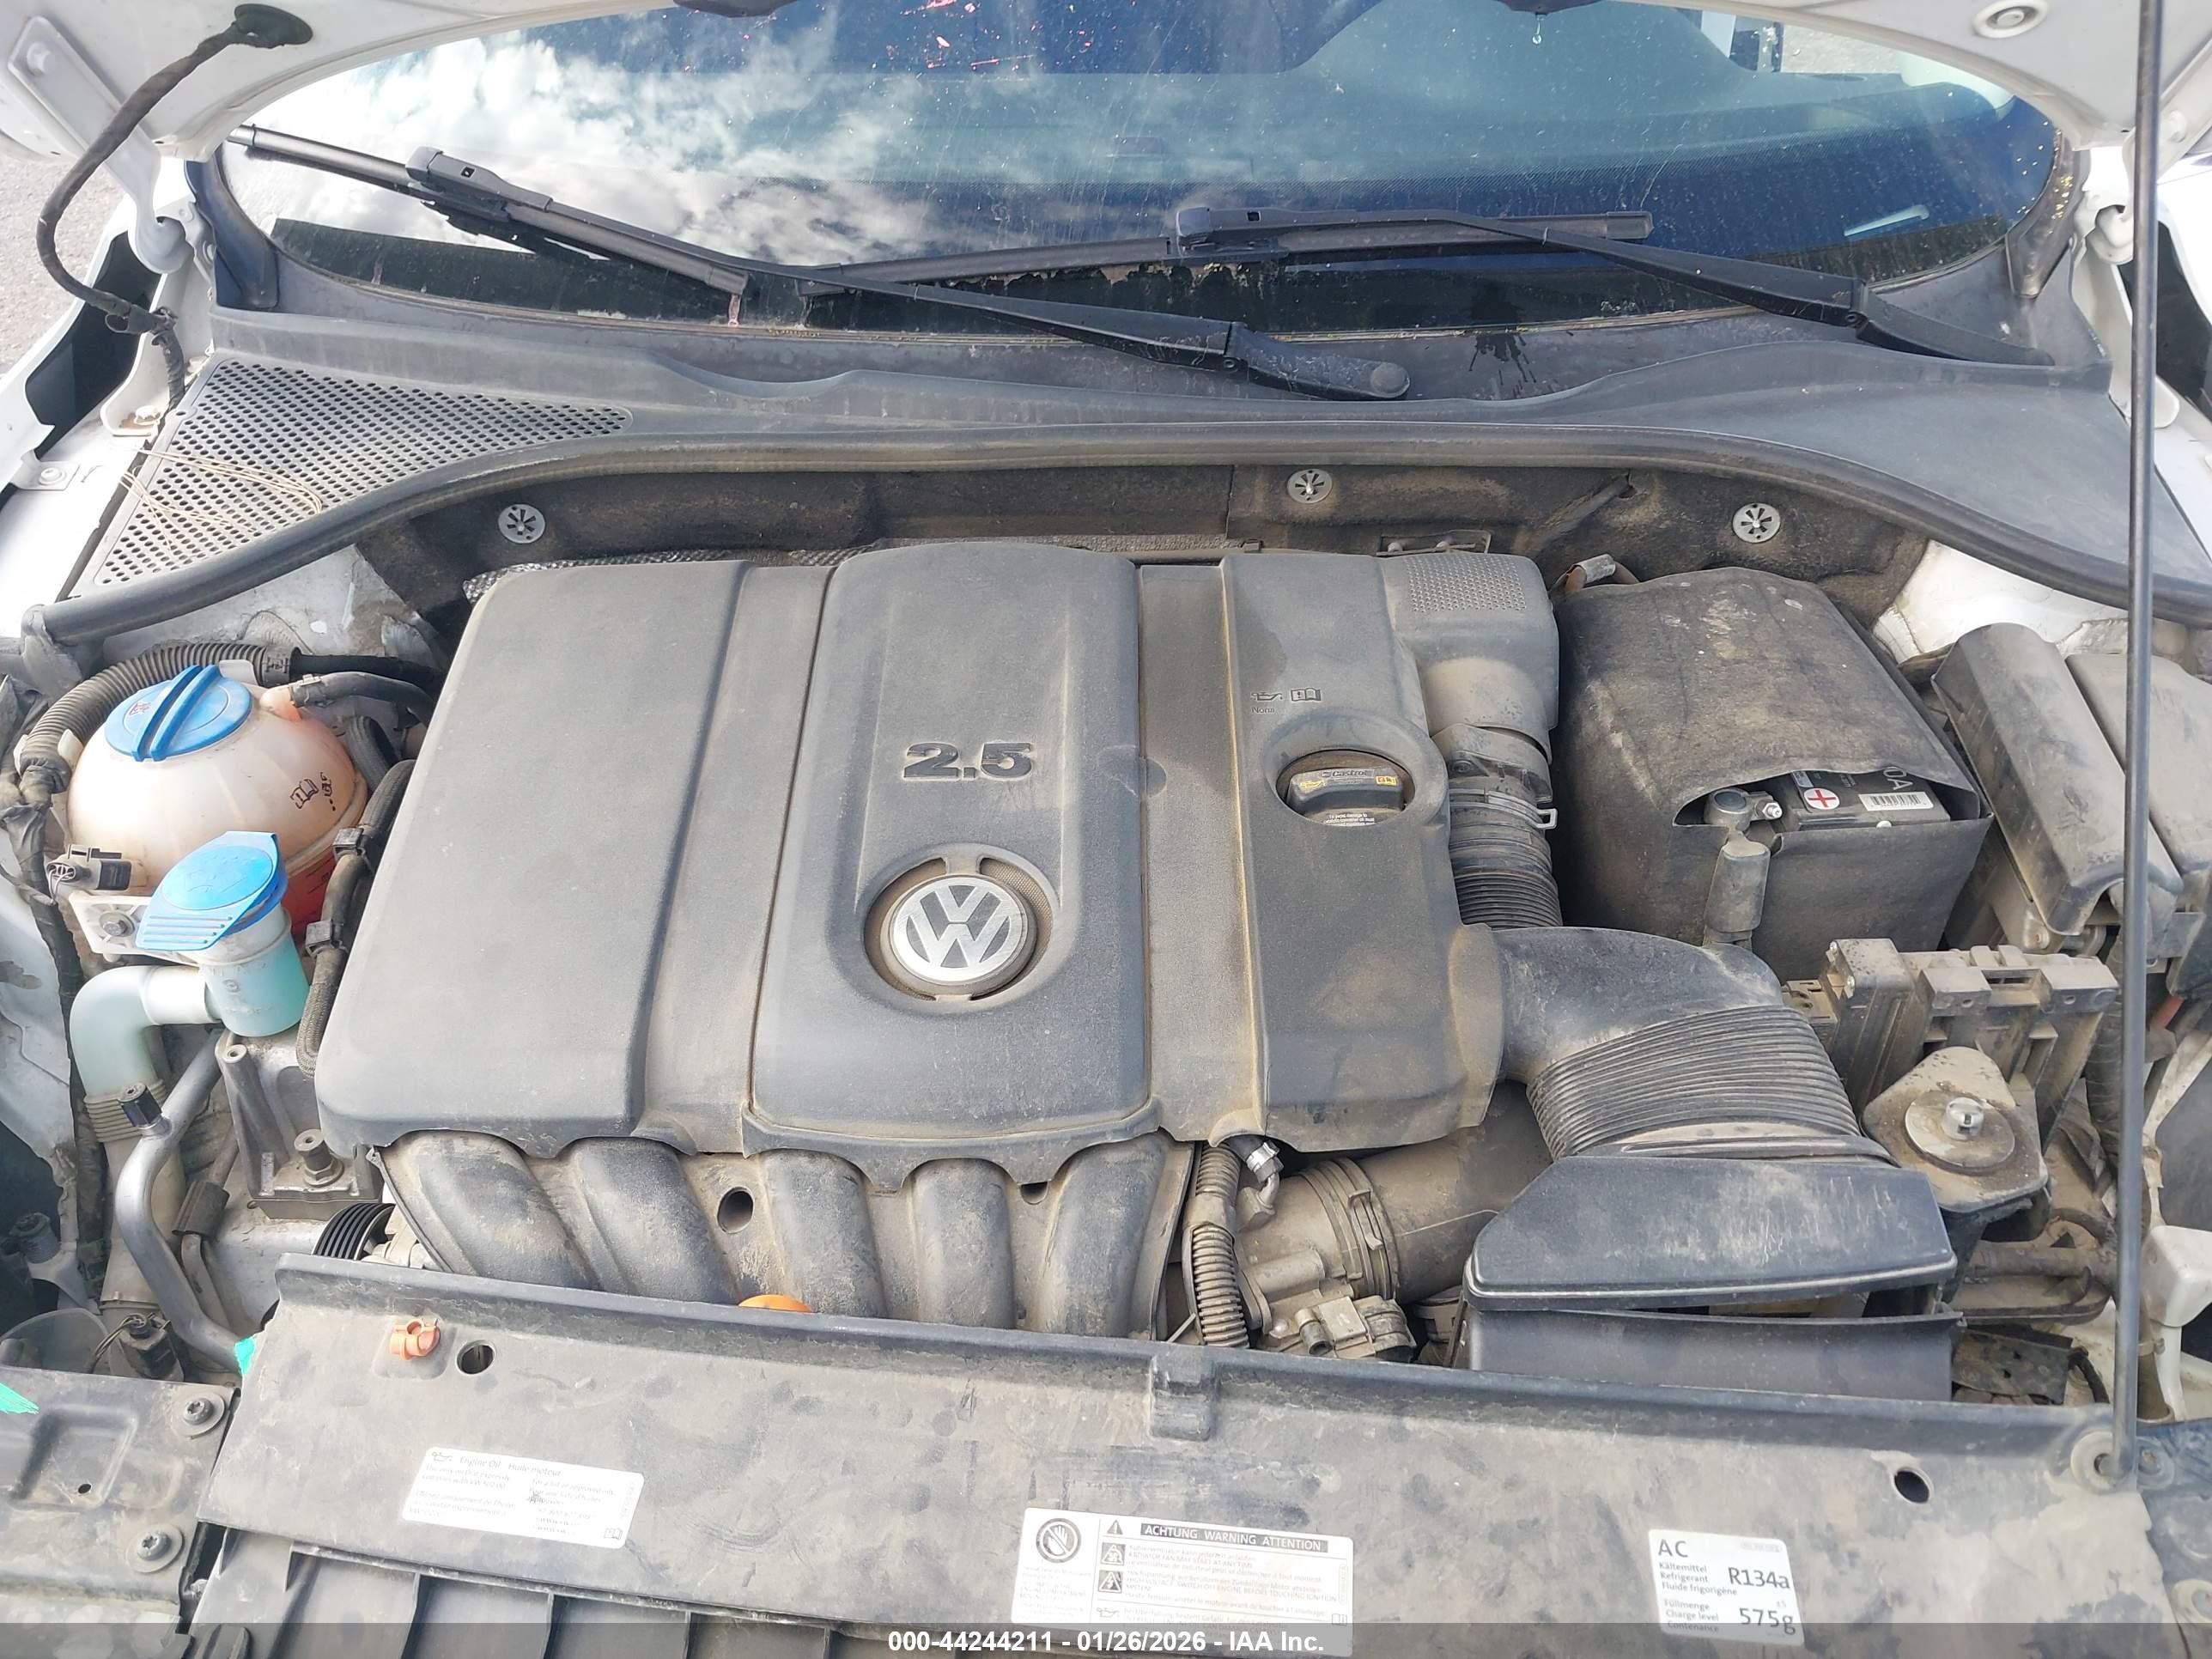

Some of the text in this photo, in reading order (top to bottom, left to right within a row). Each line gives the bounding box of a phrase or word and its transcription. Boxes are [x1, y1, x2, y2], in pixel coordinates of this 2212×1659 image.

[903, 742, 1032, 780] 2.5
[897, 880, 1020, 976] VW
[460, 1455, 488, 1467] Engine
[489, 1460, 501, 1469] Oil
[508, 1462, 530, 1472] Huile
[1145, 1524, 1322, 1551] ACHTUNG WARNING ATTENTION
[1658, 1539, 1688, 1558] AC
[1659, 1562, 1707, 1573] Kältemittel
[1661, 1572, 1708, 1583] Refrigerant
[1728, 1567, 1790, 1589] R134a
[1662, 1582, 1737, 1597] Fluide frigorigène
[1664, 1598, 1710, 1611] Füllmenge
[1666, 1608, 1719, 1622] Charge level
[1739, 1607, 1796, 1636] 575g
[1668, 1620, 1719, 1632] Contenance
